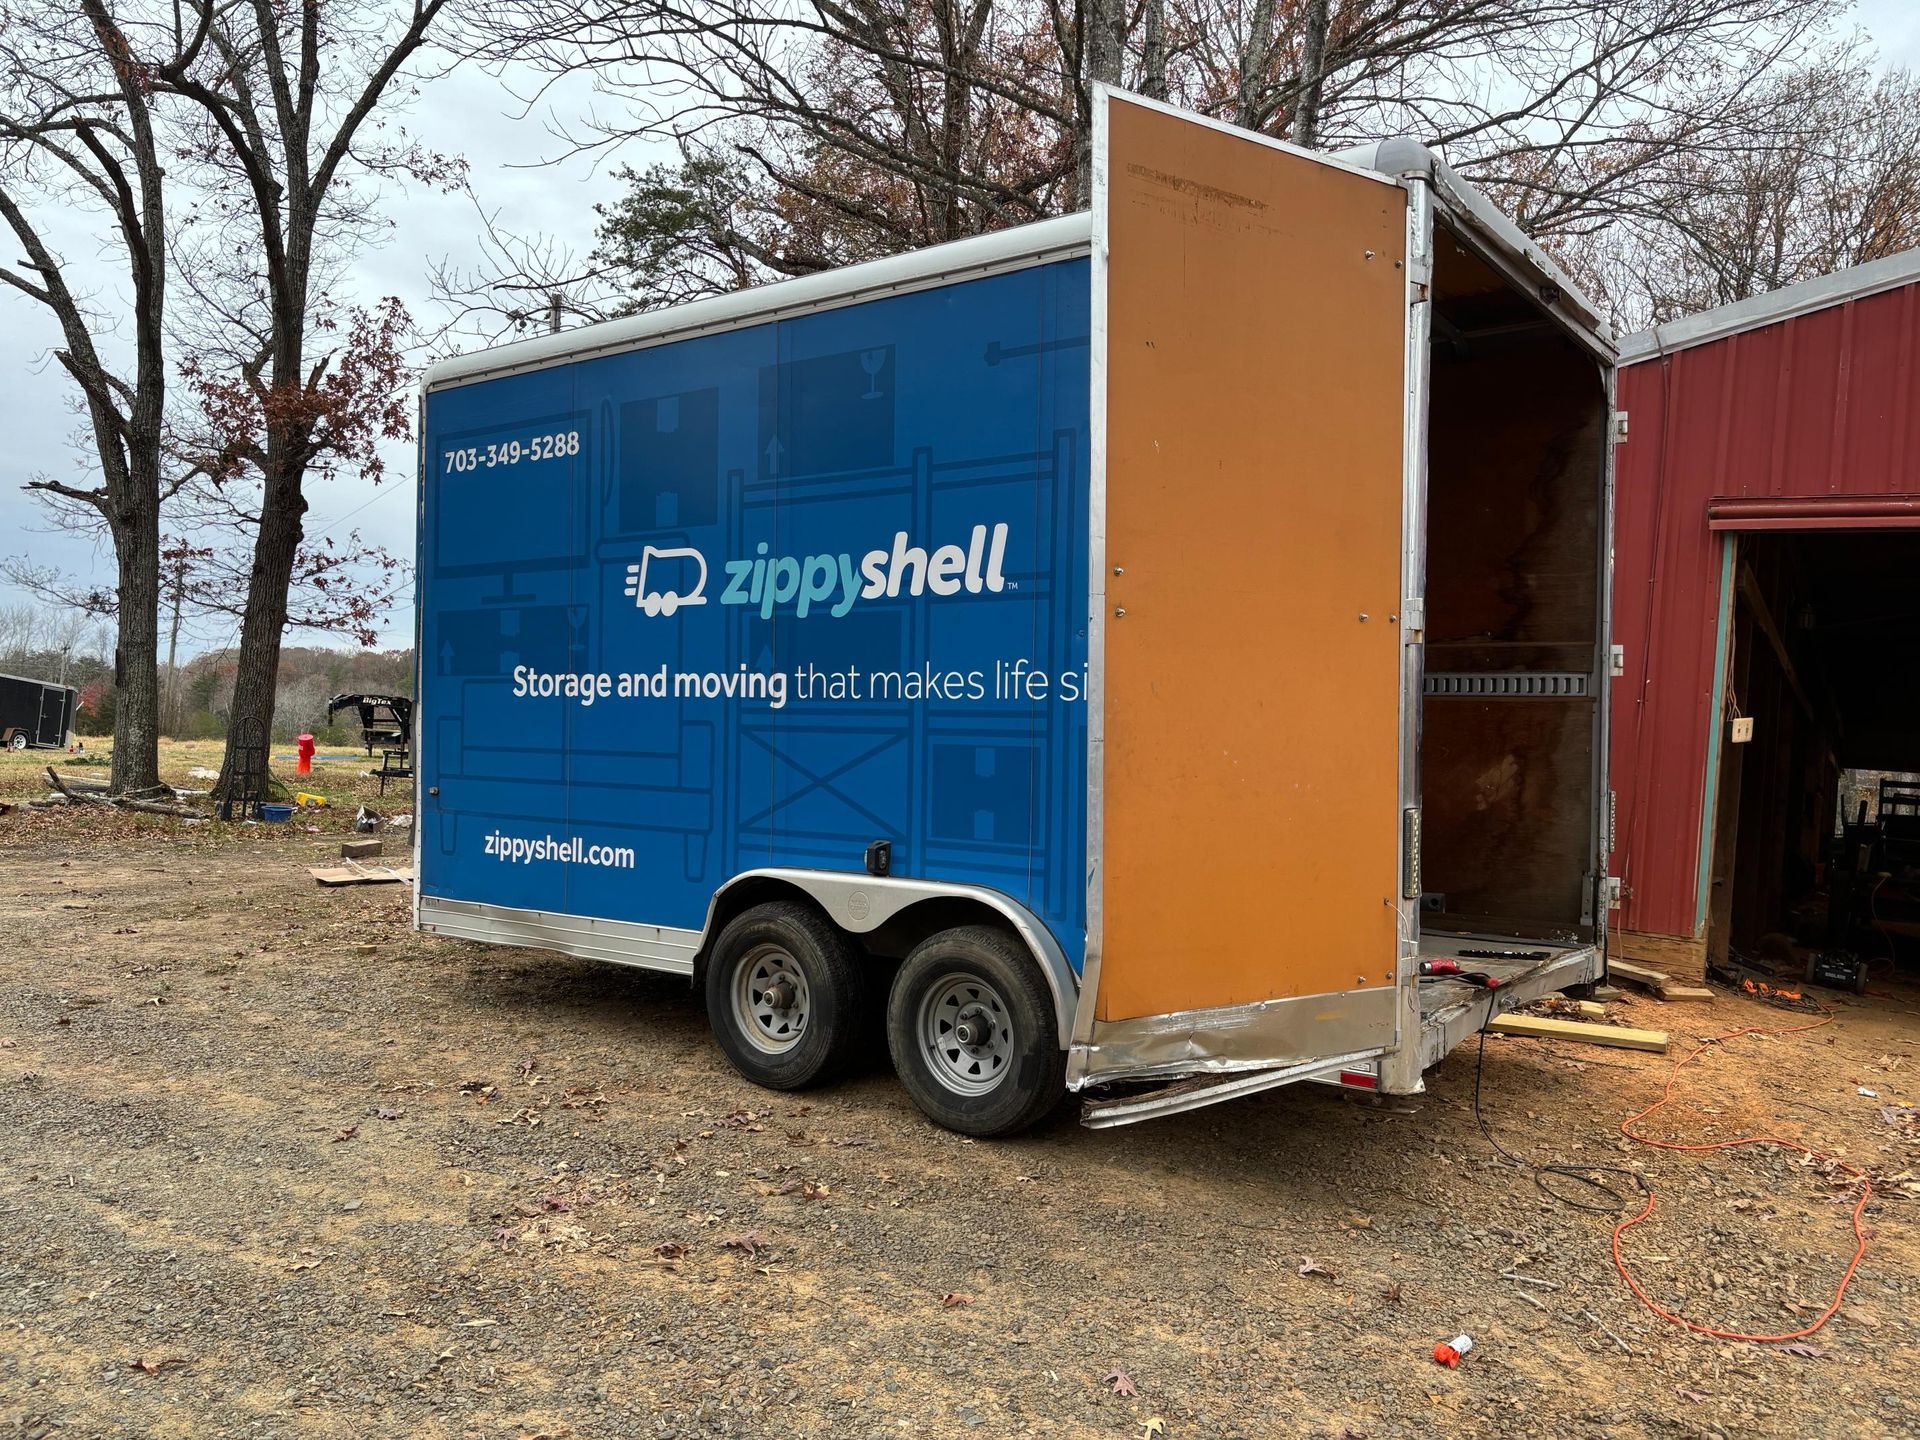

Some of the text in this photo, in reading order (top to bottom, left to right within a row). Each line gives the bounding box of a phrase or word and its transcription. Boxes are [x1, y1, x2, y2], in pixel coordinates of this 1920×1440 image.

[444, 430, 580, 474] 703-349-5288
[719, 522, 1009, 620] zippyshell
[362, 697, 392, 705] BigTex
[512, 658, 1088, 709] Storage and moving that makes life si
[484, 829, 635, 869] zippyshell.com
